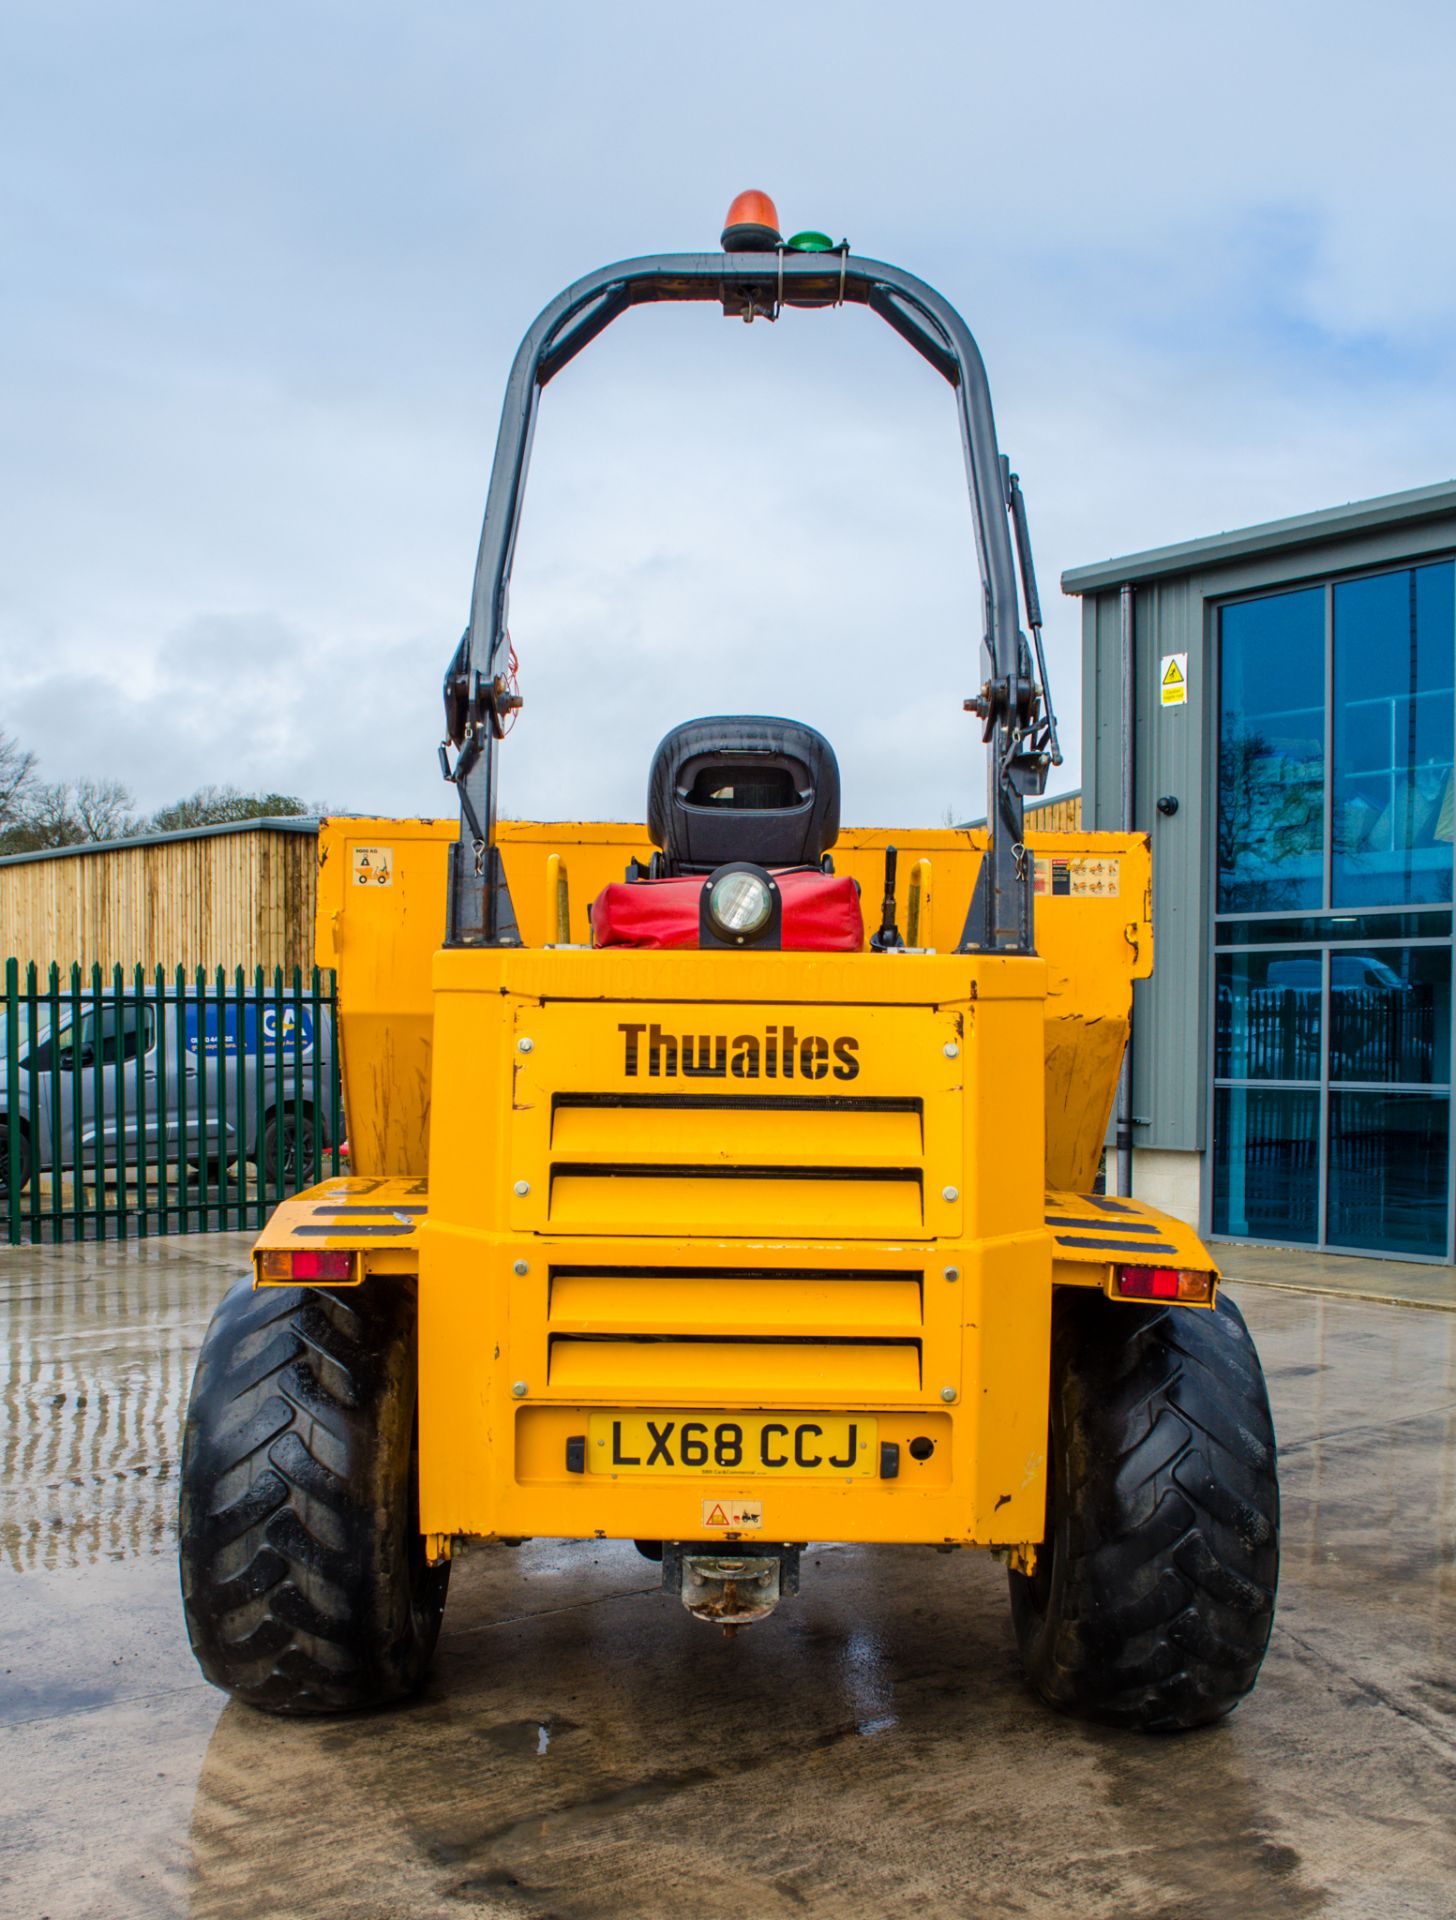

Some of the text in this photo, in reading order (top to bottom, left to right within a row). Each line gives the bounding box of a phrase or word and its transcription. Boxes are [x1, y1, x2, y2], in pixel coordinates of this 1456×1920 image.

[618, 1024, 859, 1080] Thwaites
[613, 1421, 857, 1468] LX68 CCJ
